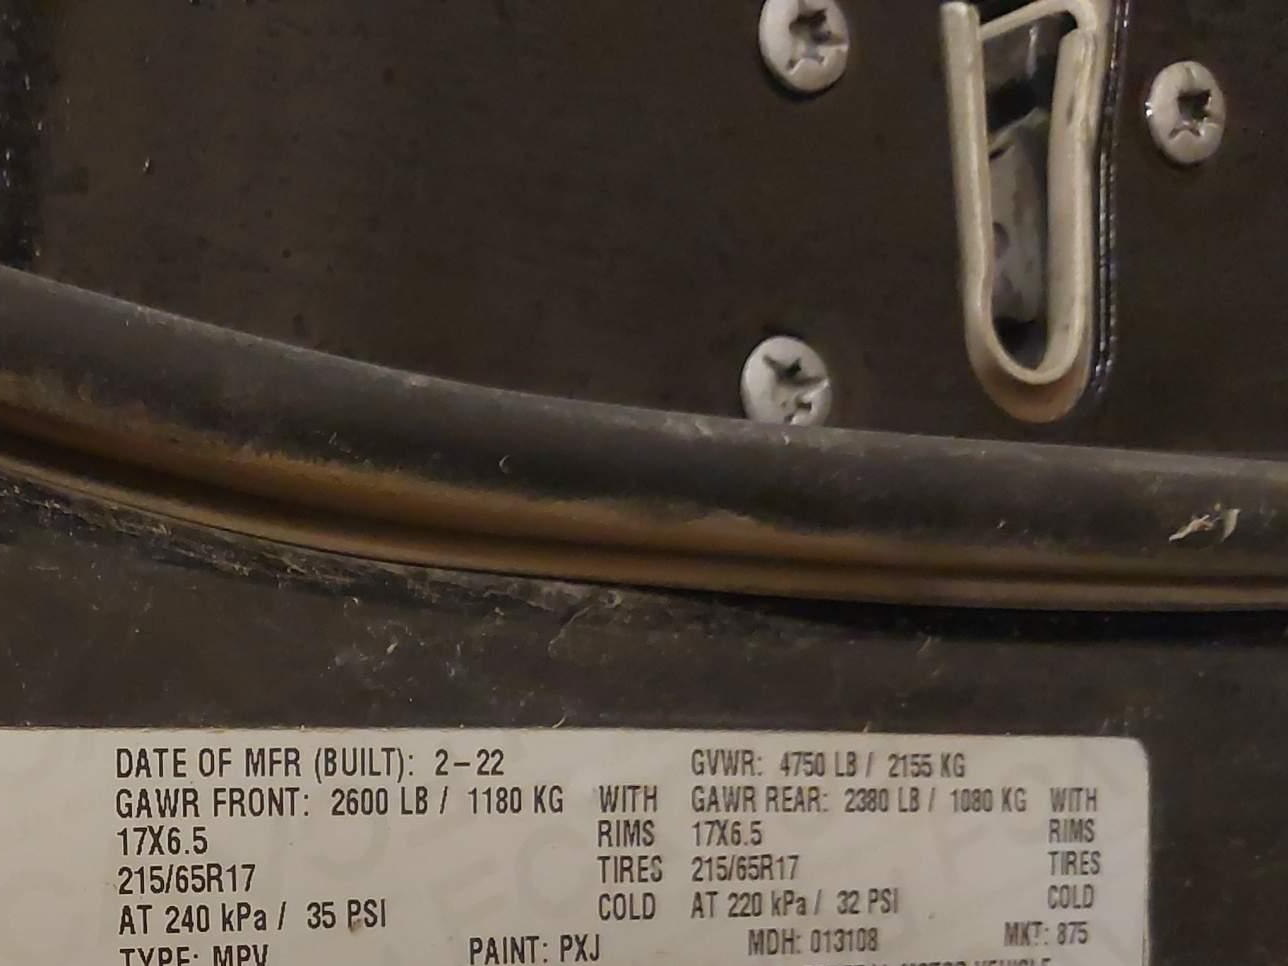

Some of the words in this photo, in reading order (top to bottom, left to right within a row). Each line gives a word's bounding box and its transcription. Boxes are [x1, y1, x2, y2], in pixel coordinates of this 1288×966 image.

[116, 748, 188, 778] DATE
[199, 748, 232, 777] OF
[245, 747, 301, 777] MFR
[314, 746, 414, 782] (BUILT):
[691, 750, 763, 776] GVWR:
[780, 753, 825, 777] 4750
[835, 753, 856, 777] LB
[865, 753, 872, 778] /
[888, 754, 932, 778] 2155
[940, 754, 965, 778] KG
[116, 788, 201, 818] GAWR
[213, 786, 309, 817] FRONT:
[330, 786, 388, 815] 2600
[401, 785, 429, 815] LB
[439, 785, 447, 815] /
[469, 785, 521, 813] 1180
[534, 784, 564, 813] KG
[598, 784, 658, 812] WITH
[691, 787, 756, 812] GAWR
[766, 787, 829, 812] REAR:
[844, 788, 889, 812] 2380
[898, 788, 919, 812] LB
[928, 788, 935, 812] /
[951, 788, 993, 812] 1080
[1002, 787, 1027, 812] KG
[1050, 788, 1097, 812] WITH
[117, 826, 208, 856] 17X6.5
[597, 820, 655, 848] RIMS
[692, 821, 762, 846] 17X6.5
[1048, 819, 1095, 843] RIMS
[597, 855, 662, 884] TIRES
[691, 856, 800, 882] 215/65R17
[1048, 850, 1101, 876] TIRES
[118, 864, 255, 894] 215/65R17
[598, 892, 656, 921] COLD
[691, 893, 718, 918] AT
[728, 891, 763, 918] 220
[771, 890, 807, 917] kPa
[814, 889, 822, 916] /
[837, 889, 860, 915] 32
[867, 889, 899, 914] PSI
[1048, 884, 1095, 910] COLD
[119, 906, 153, 936] AT
[165, 904, 210, 934] 240
[222, 902, 266, 932] kPa
[277, 901, 287, 931] /
[307, 900, 337, 929] 35
[347, 899, 387, 928] PSI
[748, 930, 802, 956] MDH:
[810, 928, 878, 953] 013108
[1004, 922, 1049, 947] MKT:
[1056, 921, 1088, 946] 875
[469, 936, 549, 966] PAINT:
[560, 934, 600, 963] PXJ
